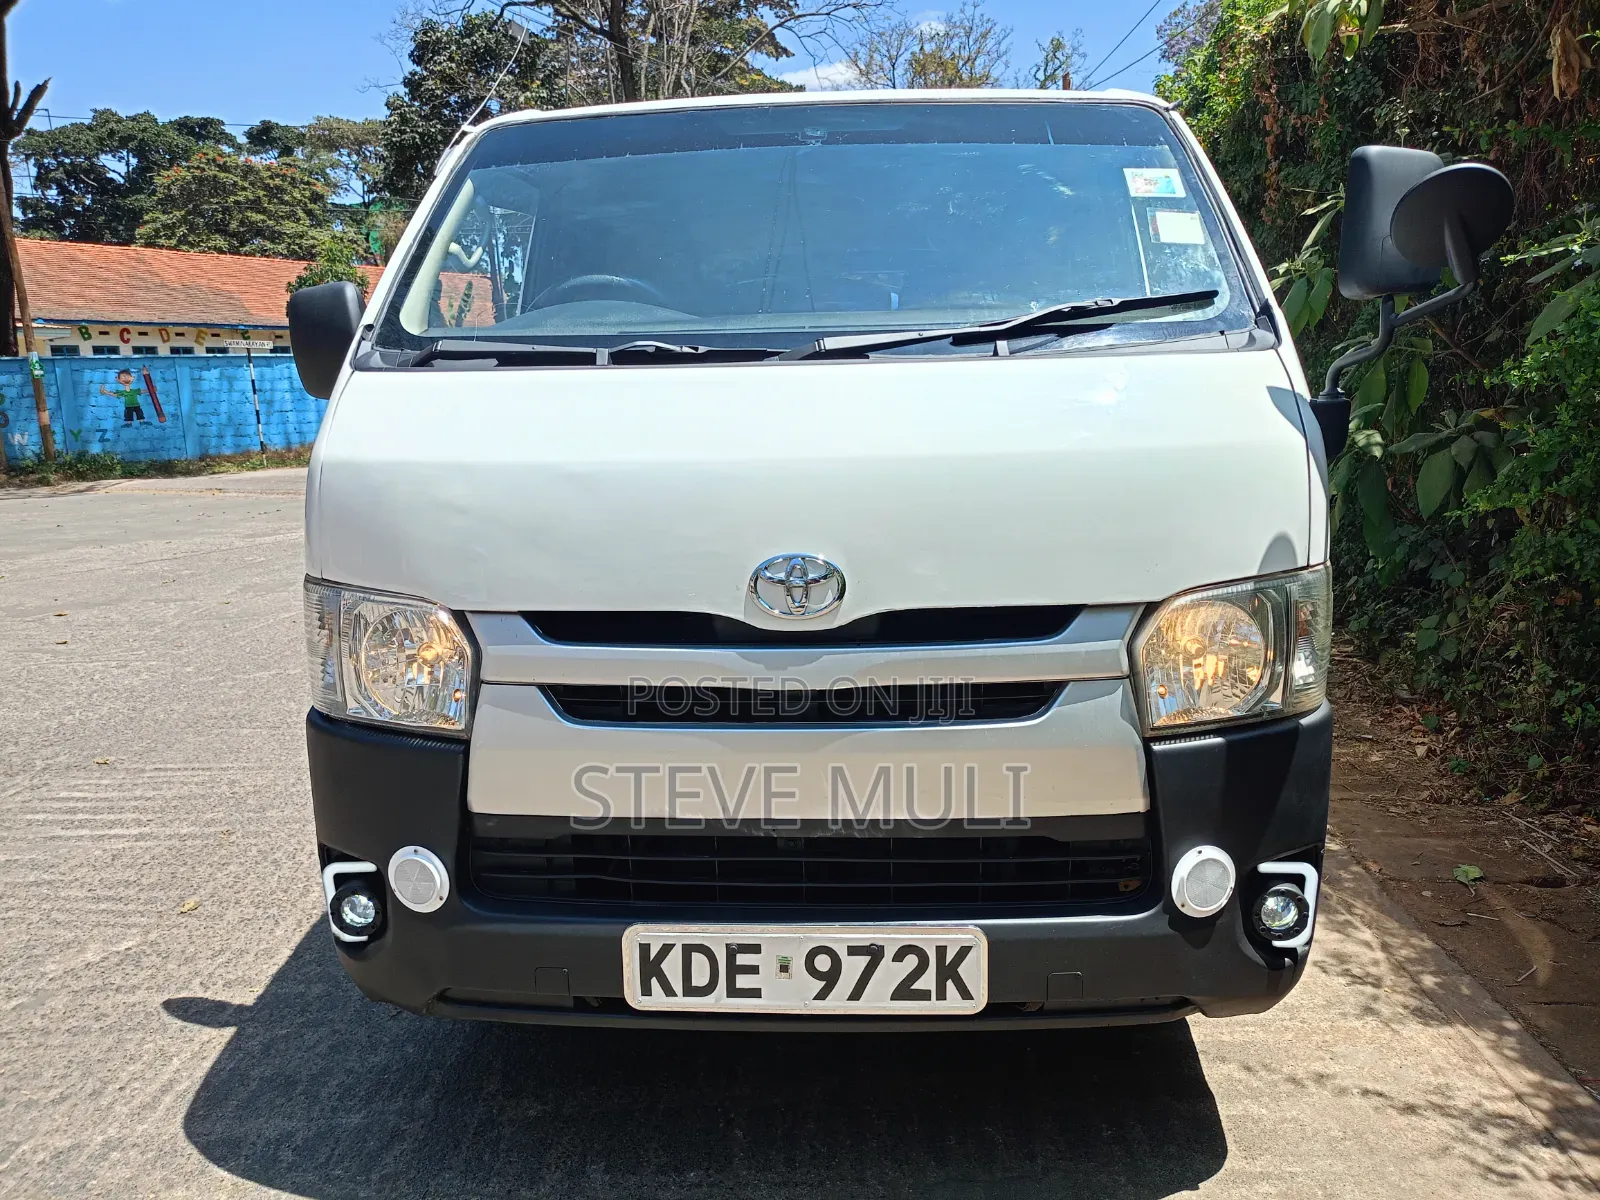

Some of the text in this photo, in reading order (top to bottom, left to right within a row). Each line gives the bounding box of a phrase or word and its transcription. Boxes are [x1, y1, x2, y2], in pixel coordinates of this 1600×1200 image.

[78, 326, 92, 341] B
[119, 328, 131, 344] C
[158, 328, 170, 344] D
[195, 328, 208, 347] E
[8, 432, 28, 445] W
[70, 429, 82, 442] Y
[96, 429, 110, 442] Z
[638, 943, 974, 1002] KDE 972K
